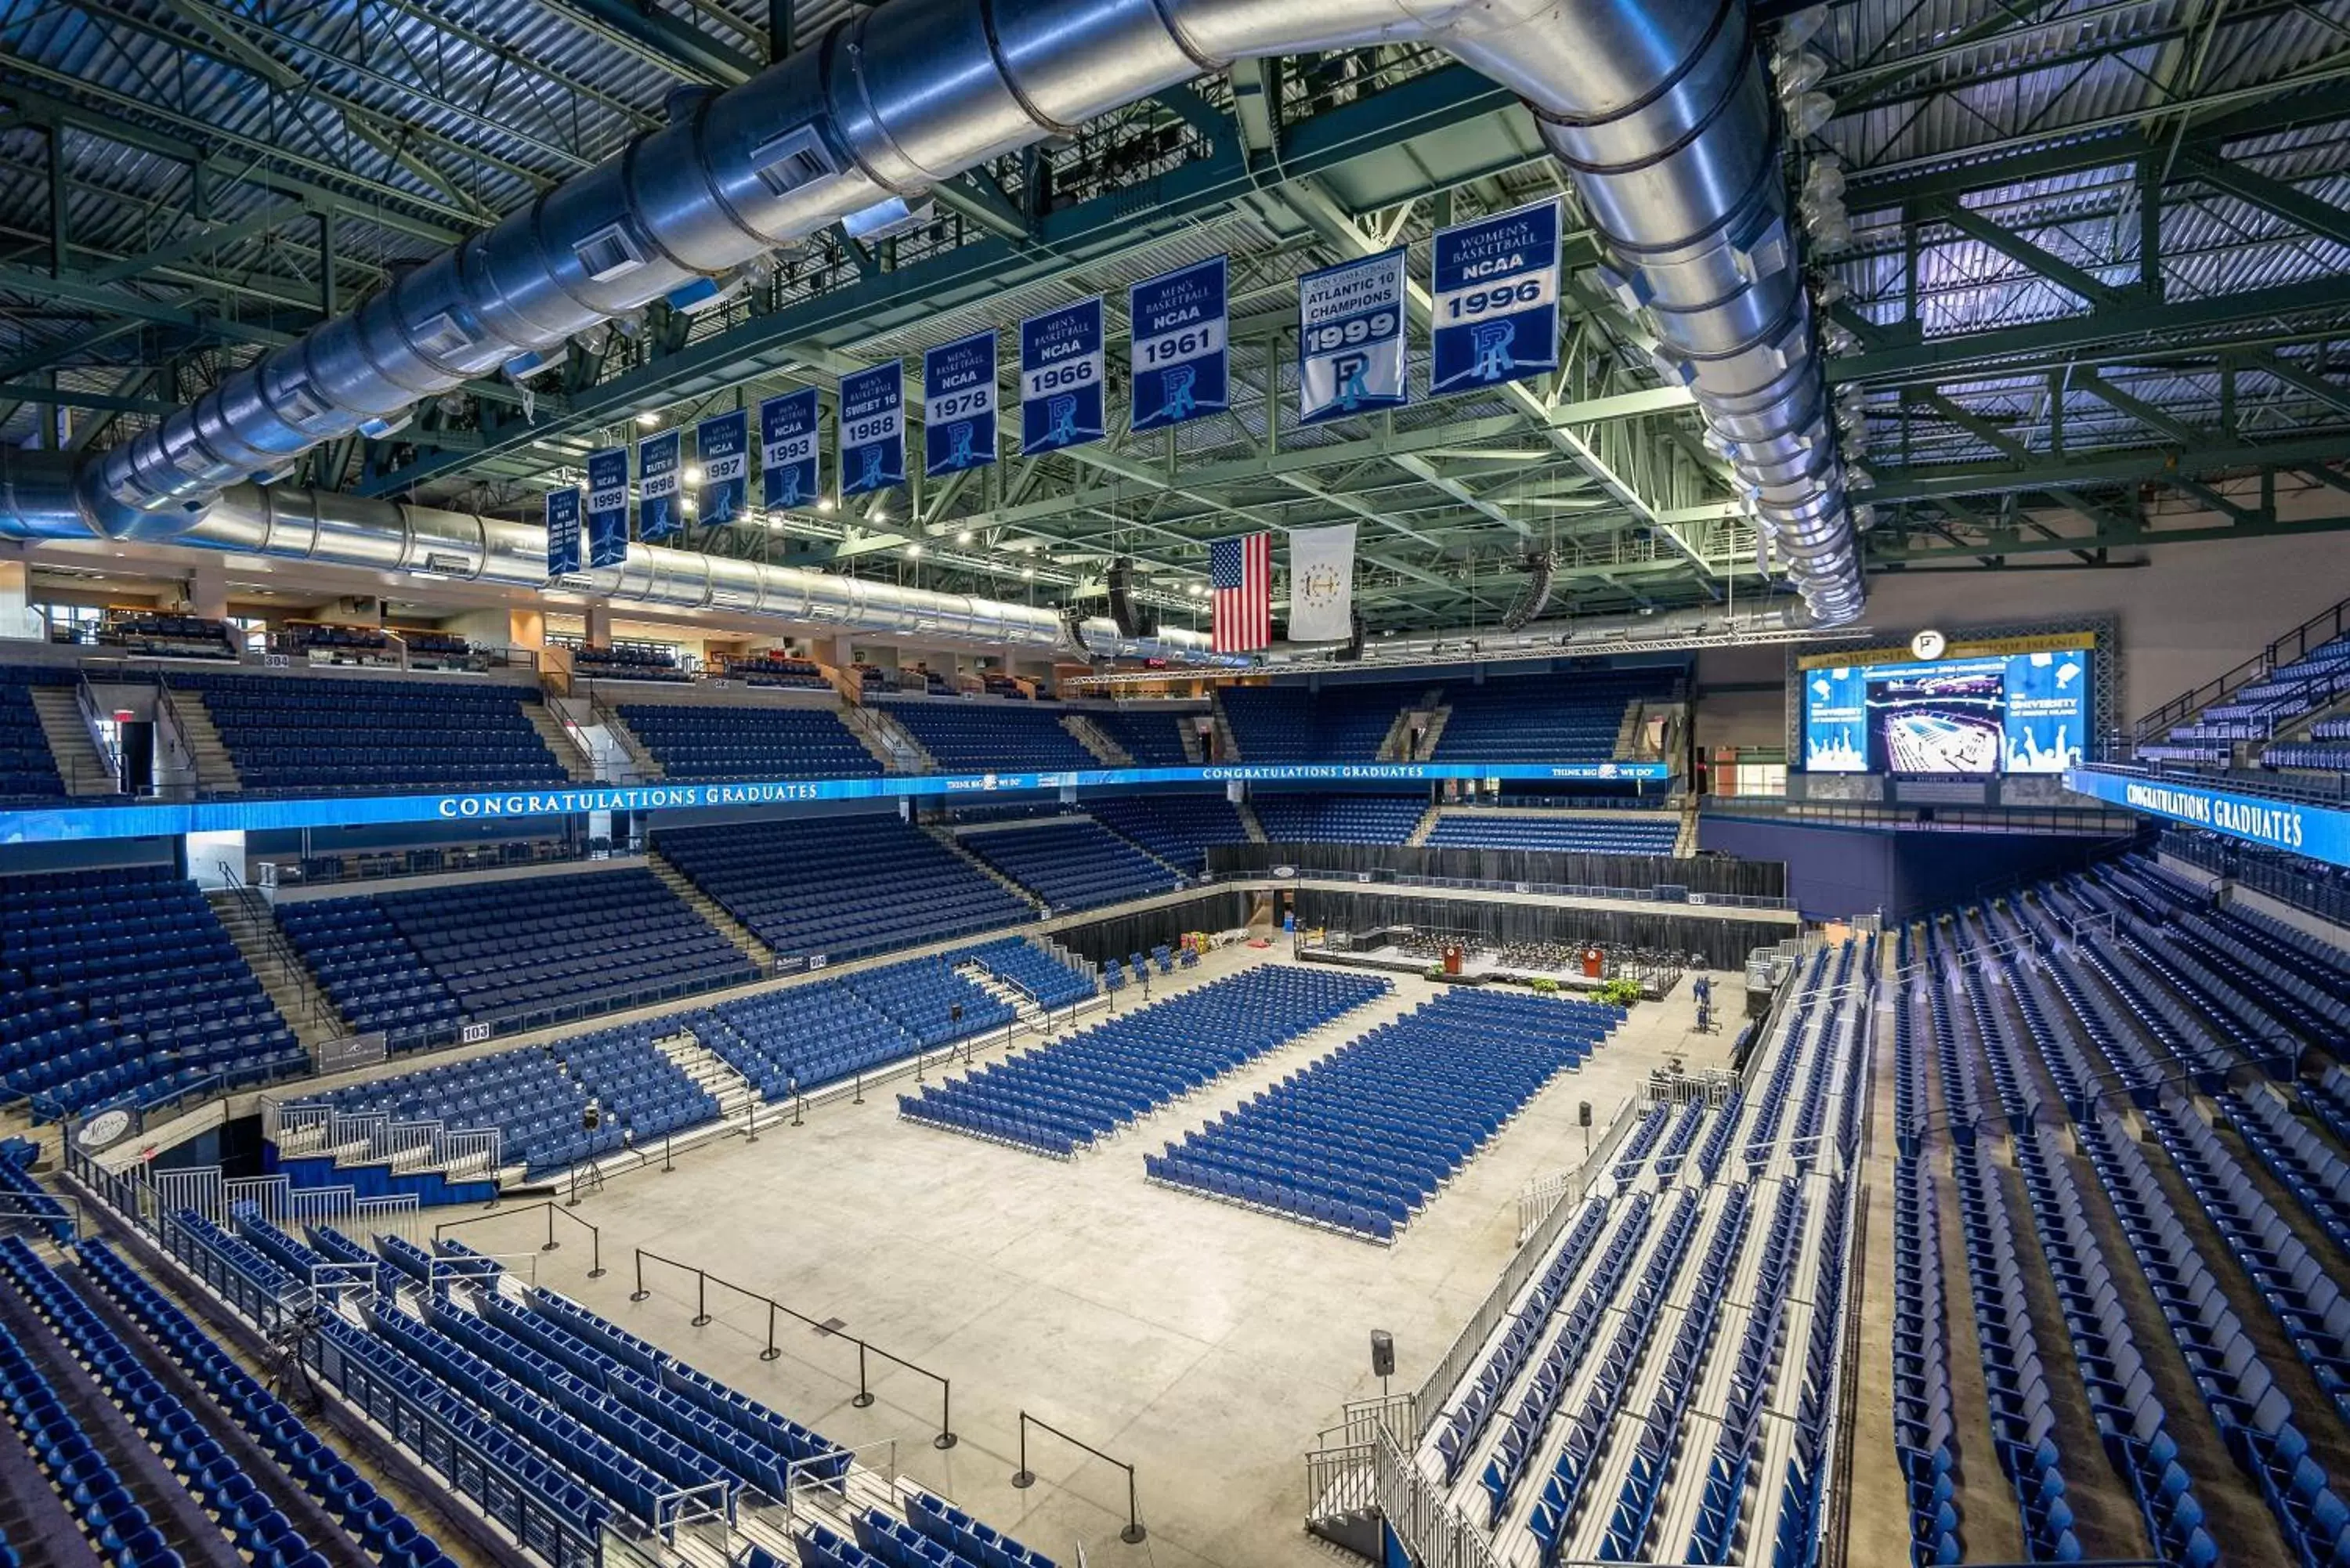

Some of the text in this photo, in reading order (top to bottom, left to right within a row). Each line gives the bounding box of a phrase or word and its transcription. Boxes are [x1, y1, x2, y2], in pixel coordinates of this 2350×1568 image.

[1453, 233, 1537, 263] BASKETBALL
[1461, 222, 1529, 248] WOMEN'S
[1462, 253, 1524, 280] NCAA
[1146, 287, 1209, 314] BASKETBALL
[1160, 279, 1194, 299] MEN'S
[1307, 272, 1395, 305] ATLANTIC 10
[1448, 280, 1541, 318] 1996
[1154, 305, 1201, 330] NCAA
[1311, 289, 1392, 320] CHAMPIONS
[1145, 328, 1209, 363] 1961
[1307, 313, 1395, 352] 1999
[1041, 339, 1081, 361] NCAA
[942, 370, 978, 389] NCAA
[1032, 361, 1093, 392] 1966
[845, 393, 897, 417] SWEET 16
[934, 391, 987, 418] 1978
[775, 421, 802, 437] NCAA
[849, 415, 894, 442] 1988
[769, 439, 809, 463] 1993
[705, 458, 740, 480] 1997
[645, 475, 674, 495] 1998
[593, 491, 623, 508] 1999
[1202, 767, 1423, 779] CONGRATULATIONS GRADUATES
[439, 783, 818, 818] CONGRATULATIONS GRADUATES
[2127, 784, 2303, 847] CONGRATULATIONS GRADUATES
[465, 1026, 487, 1040] 103
